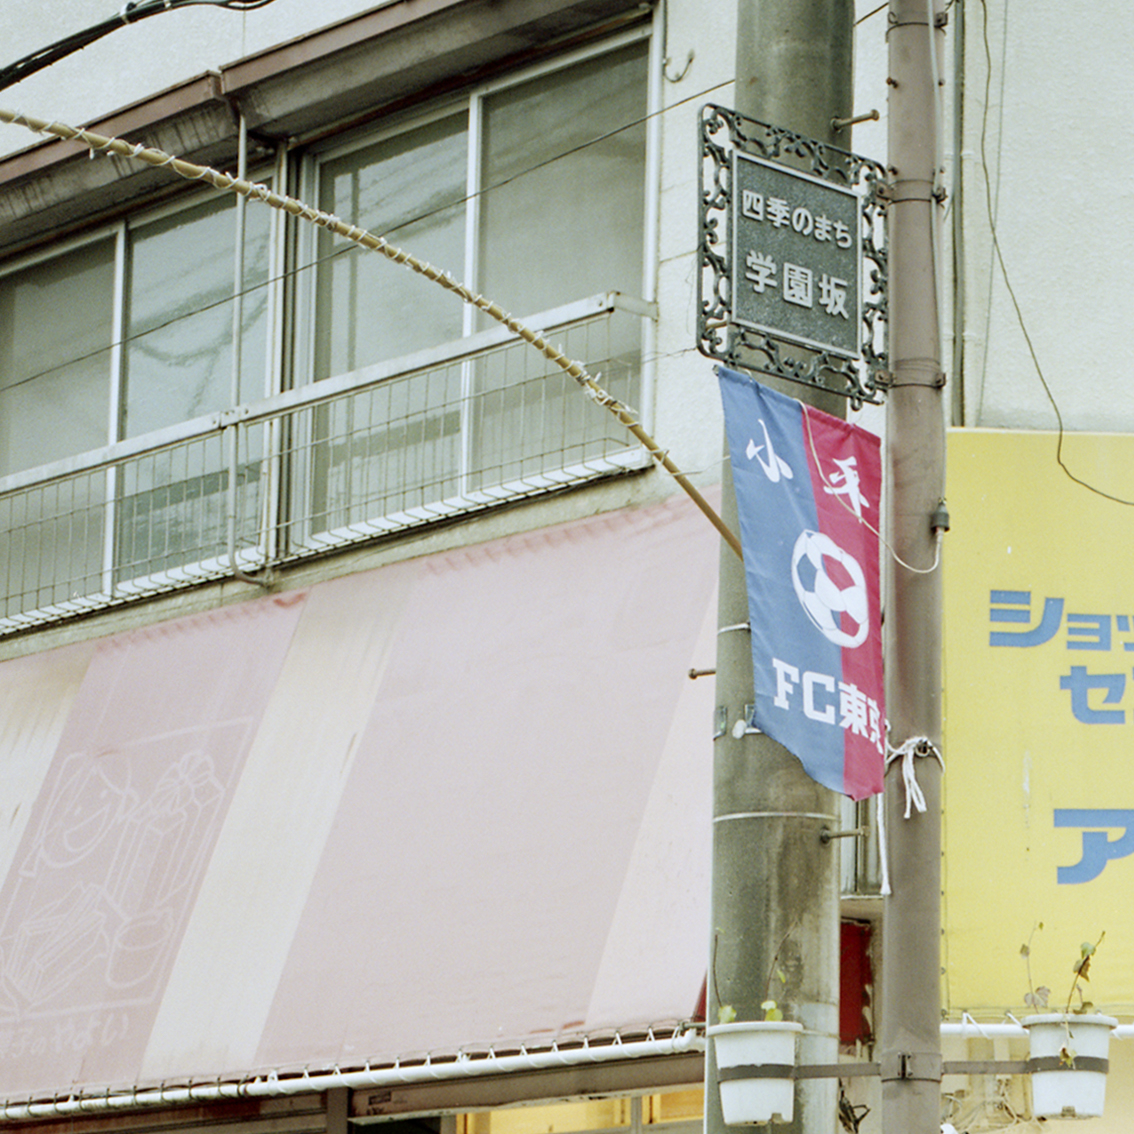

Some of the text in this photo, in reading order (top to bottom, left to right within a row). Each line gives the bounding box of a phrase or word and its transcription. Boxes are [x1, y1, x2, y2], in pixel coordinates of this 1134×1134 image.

[742, 189, 852, 249] 四季のまち
[745, 251, 849, 319] 学園坂
